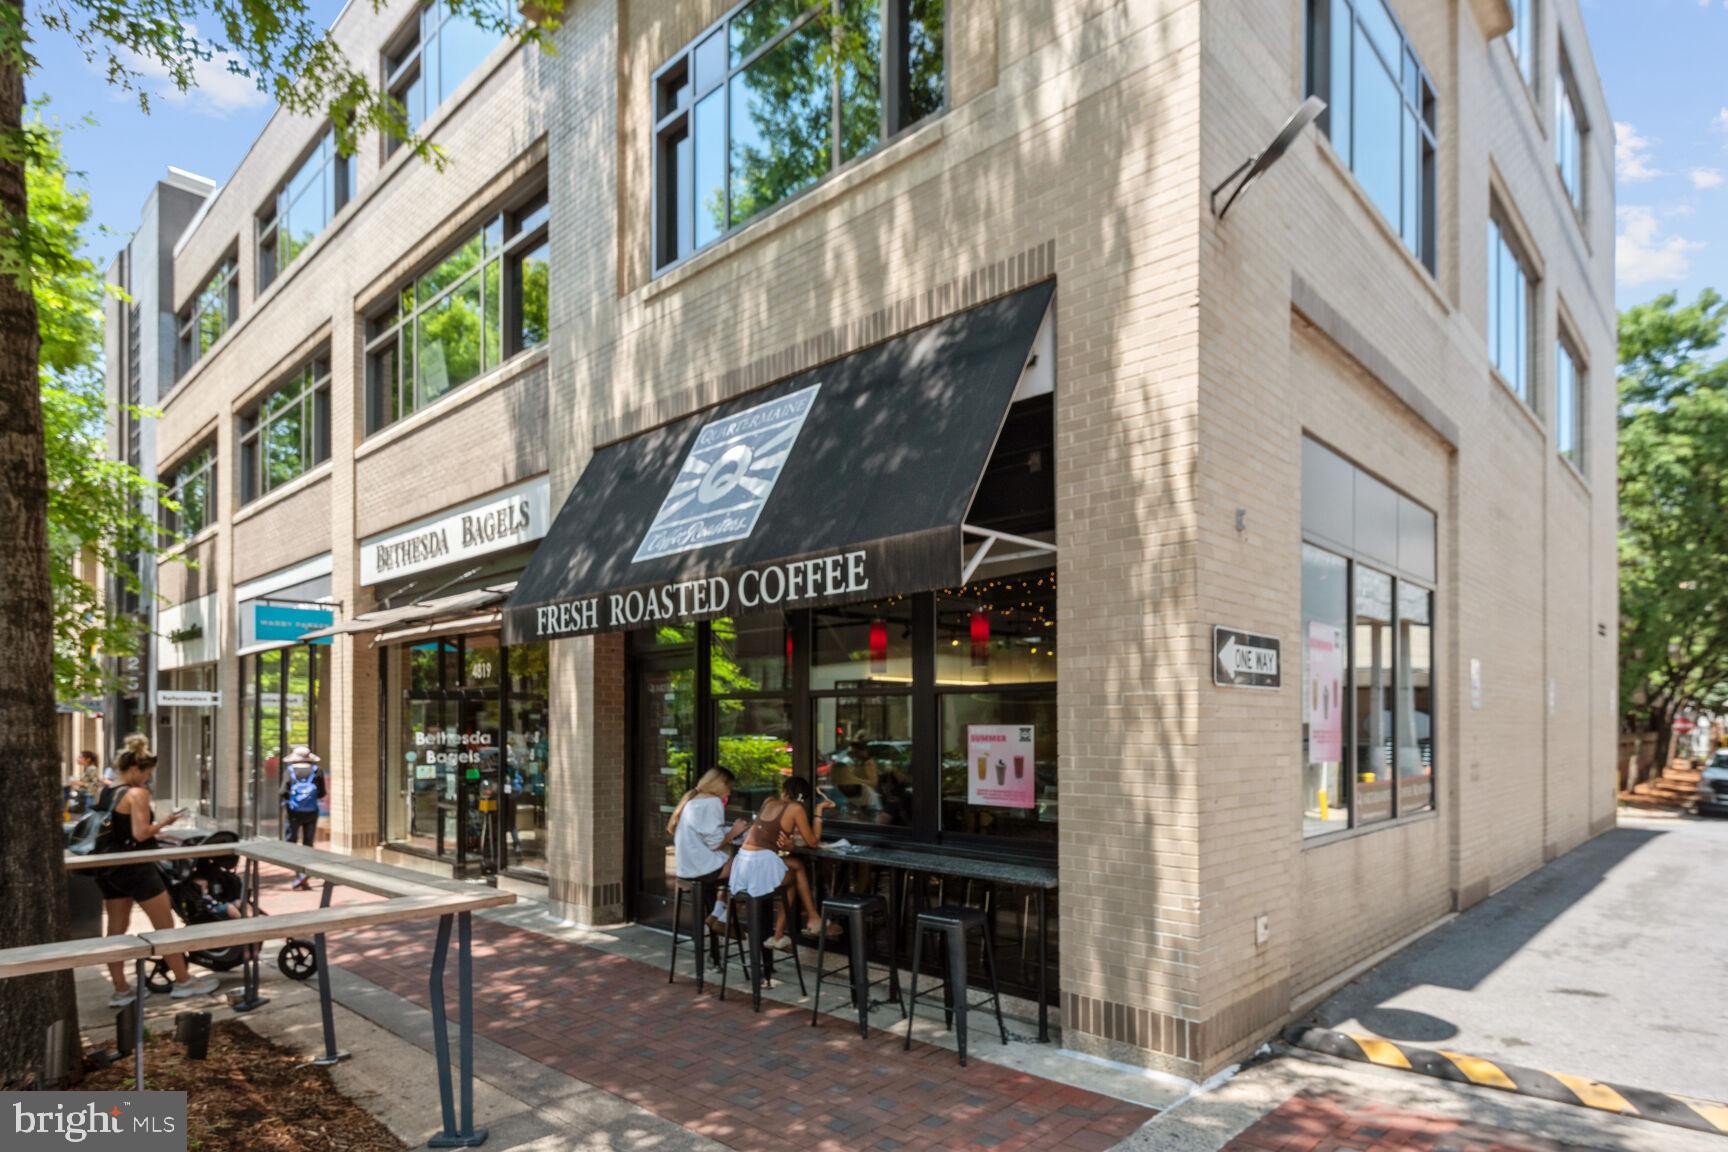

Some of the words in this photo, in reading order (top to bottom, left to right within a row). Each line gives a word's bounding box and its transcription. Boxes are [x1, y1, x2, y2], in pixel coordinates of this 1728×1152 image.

[700, 401, 806, 445] QUARTERMAINE
[376, 527, 449, 573] BETHESDA
[461, 500, 530, 548] BAGELS
[536, 598, 599, 636] FRESH
[609, 576, 730, 627] ROASTED
[737, 550, 869, 608] COFFEE
[472, 662, 493, 680] 4819
[1235, 648, 1253, 670] ONE
[1255, 651, 1275, 672] WAY
[415, 730, 492, 746] Bethesda
[425, 749, 481, 766] Bagels
